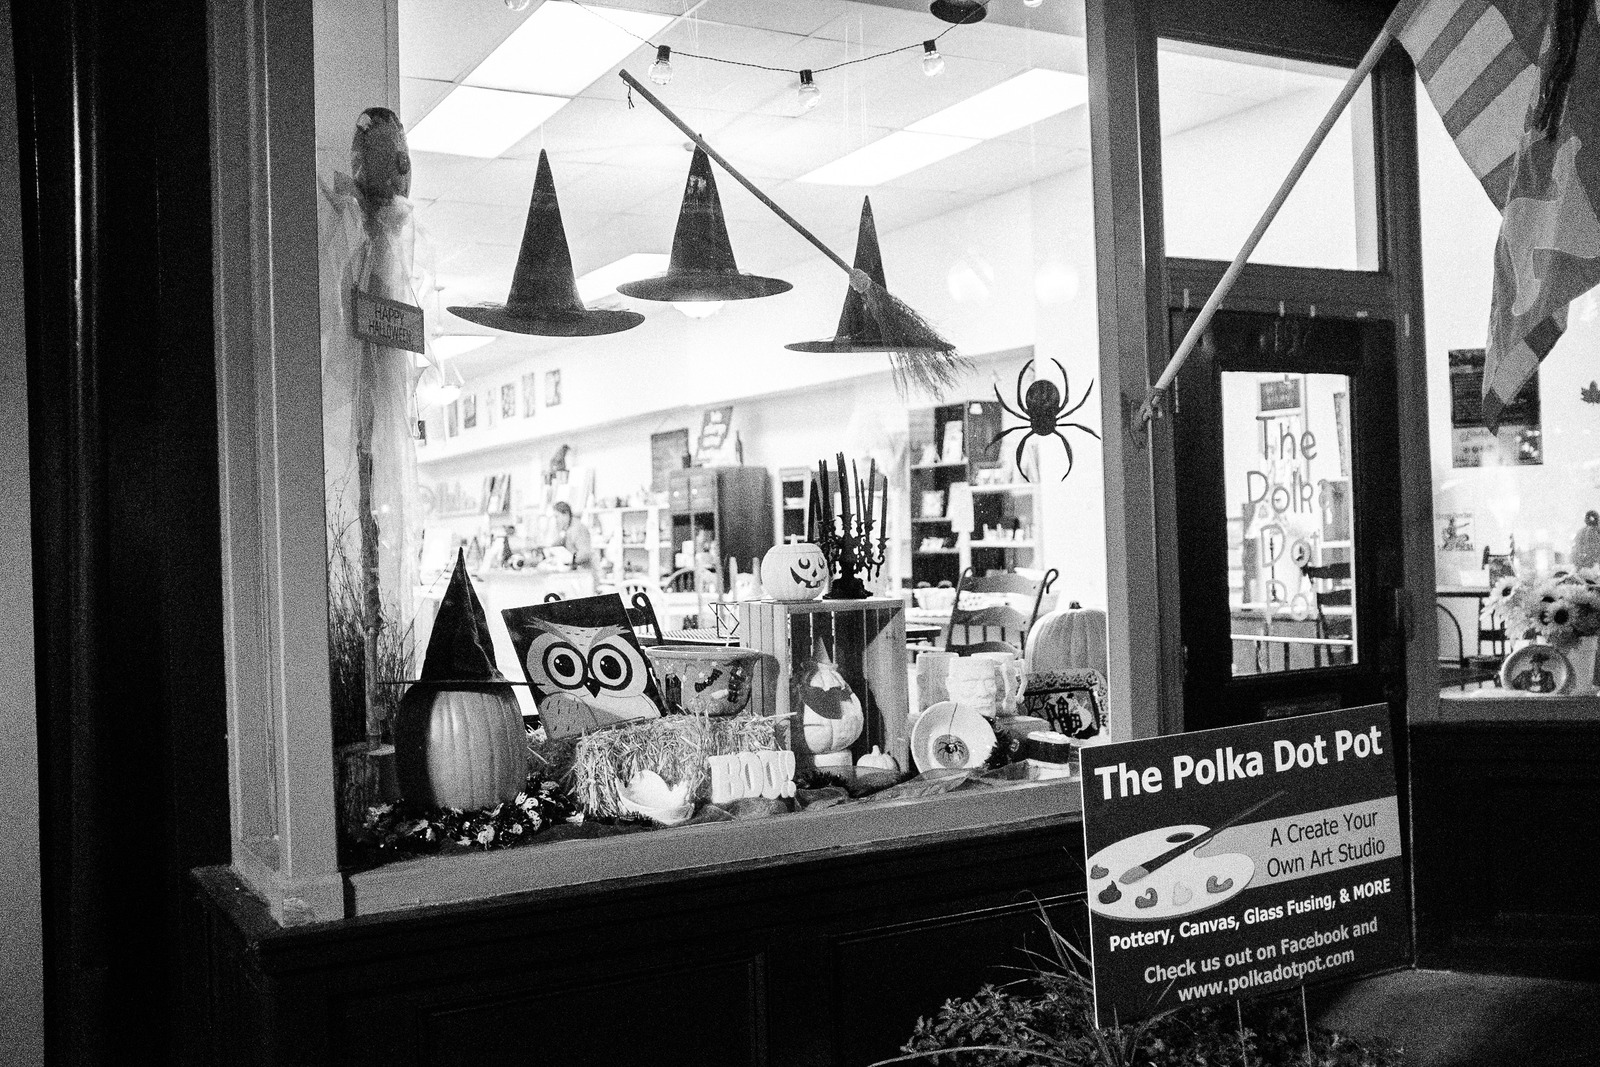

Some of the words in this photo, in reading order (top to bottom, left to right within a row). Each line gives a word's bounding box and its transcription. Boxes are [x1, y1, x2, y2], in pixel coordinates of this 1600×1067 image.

[368, 319, 414, 344] HALLOWEEN
[374, 303, 405, 326] HAPPY
[1256, 415, 1317, 460] The
[708, 750, 796, 804] BOO!
[1094, 763, 1163, 800] The
[1173, 747, 1264, 789] Polka
[1274, 734, 1328, 772] Dot
[1334, 725, 1383, 761] Pot
[1270, 827, 1282, 847] A
[1287, 818, 1339, 844] Create
[1343, 810, 1378, 831] Your
[1267, 855, 1305, 878] Own
[1310, 848, 1333, 869] Art
[1338, 837, 1385, 863] Studio
[1109, 926, 1175, 952] Pottery,
[1179, 914, 1240, 938] Canvas,
[1244, 905, 1284, 926] Glass
[1287, 894, 1337, 916] Fusing,
[1339, 886, 1350, 903] &
[1353, 877, 1391, 901] MORE
[1144, 961, 1197, 984] Check
[1200, 955, 1221, 973] us
[1225, 947, 1253, 967] out
[1256, 944, 1277, 960] on
[1280, 926, 1350, 955] Facebook
[1352, 917, 1378, 938] and
[1178, 948, 1355, 1002] www.polkadotpot.com
